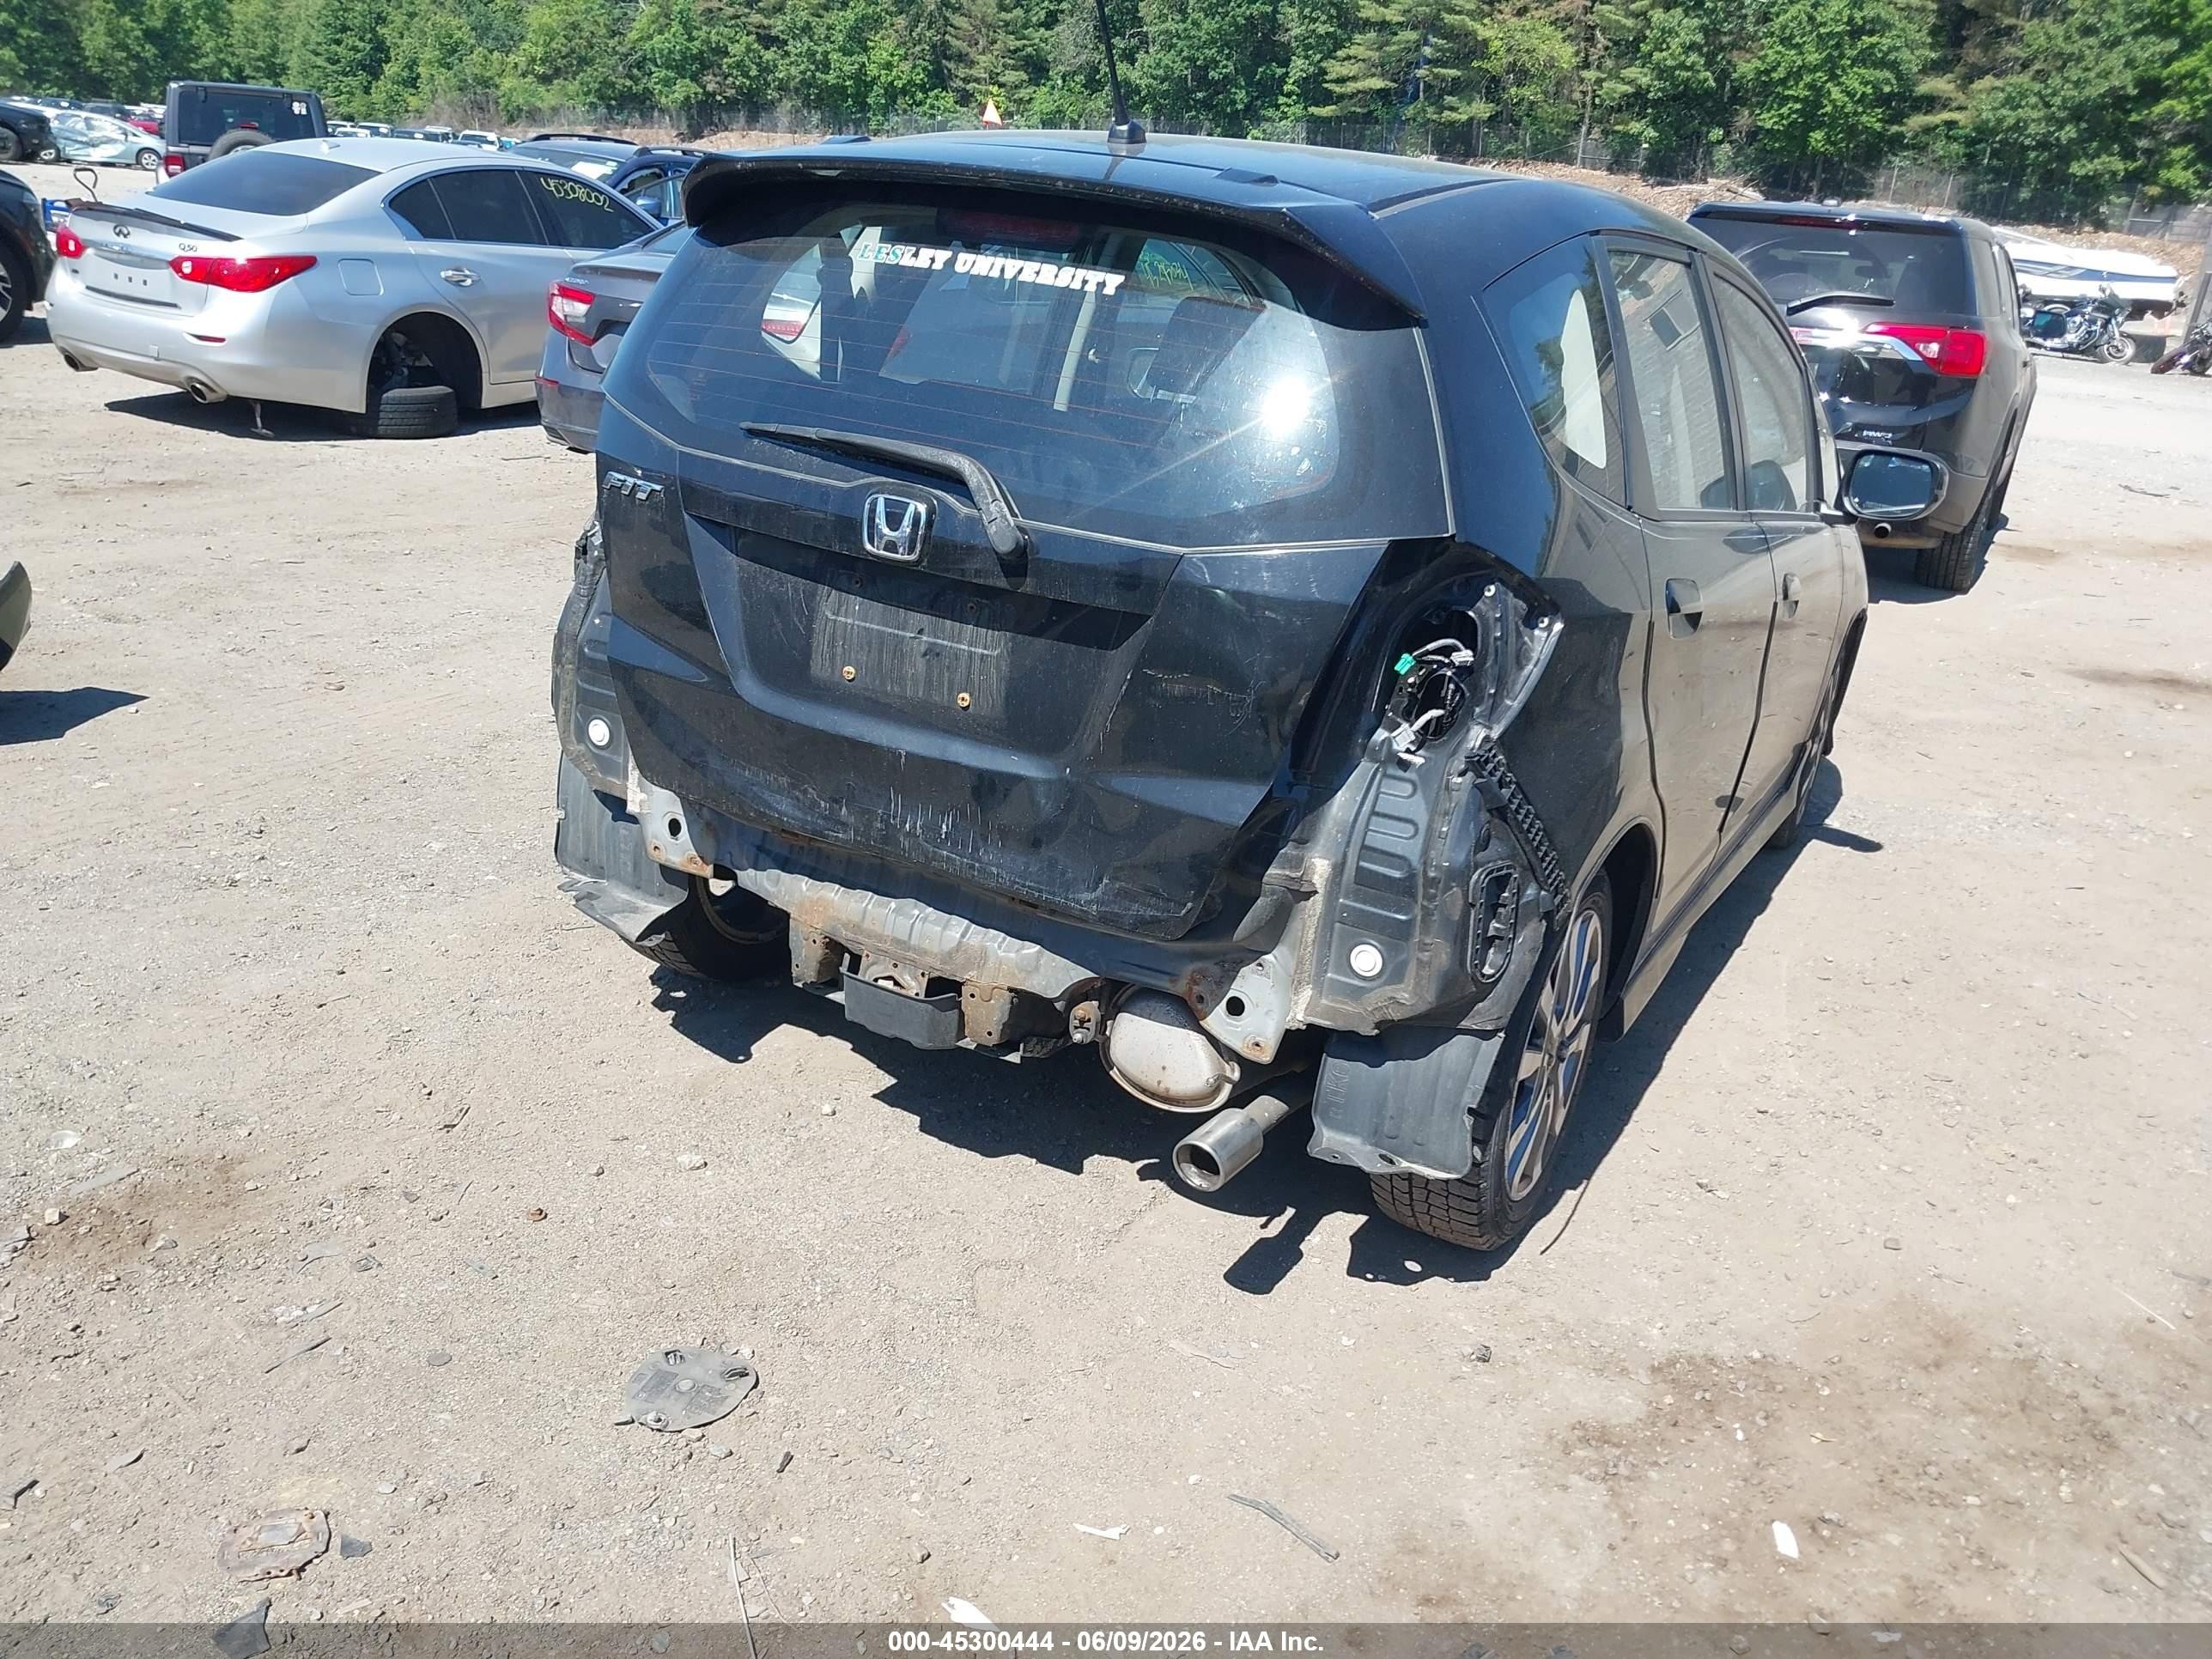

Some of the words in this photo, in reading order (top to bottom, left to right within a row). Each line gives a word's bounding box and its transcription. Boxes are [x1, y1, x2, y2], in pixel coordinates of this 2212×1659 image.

[540, 177, 614, 213] 45308002
[179, 242, 198, 252] Q50
[859, 242, 952, 270] LESLEY
[954, 252, 1125, 295] UNIVERSITY
[602, 471, 665, 501] FIT
